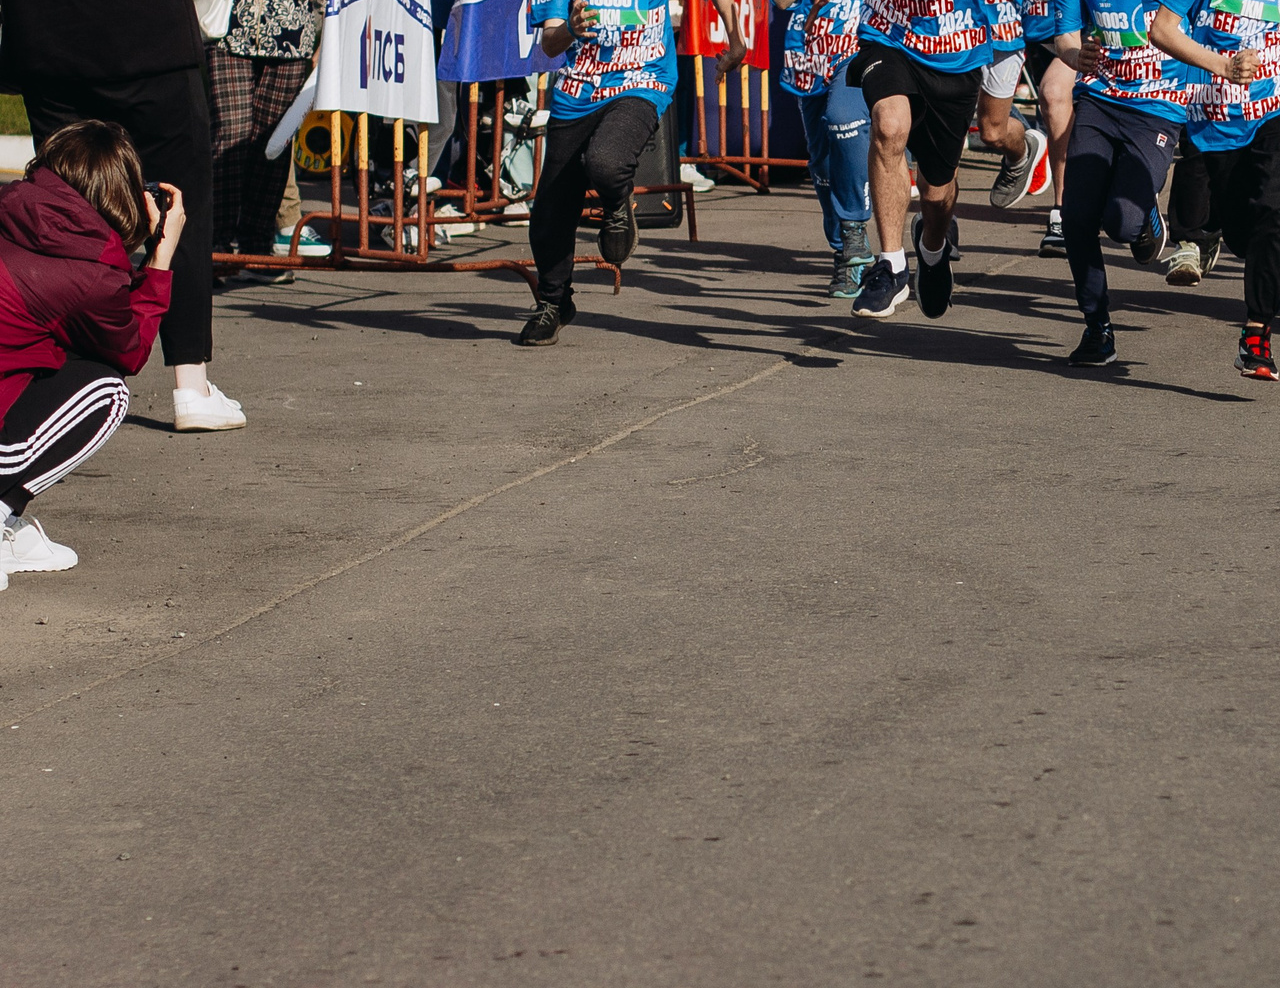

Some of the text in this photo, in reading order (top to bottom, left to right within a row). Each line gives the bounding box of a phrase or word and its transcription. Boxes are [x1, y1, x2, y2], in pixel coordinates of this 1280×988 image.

[938, 8, 975, 36] 2024
[372, 28, 405, 84] ПСБ
[1186, 83, 1250, 105] #ЛЮБОВЬ
